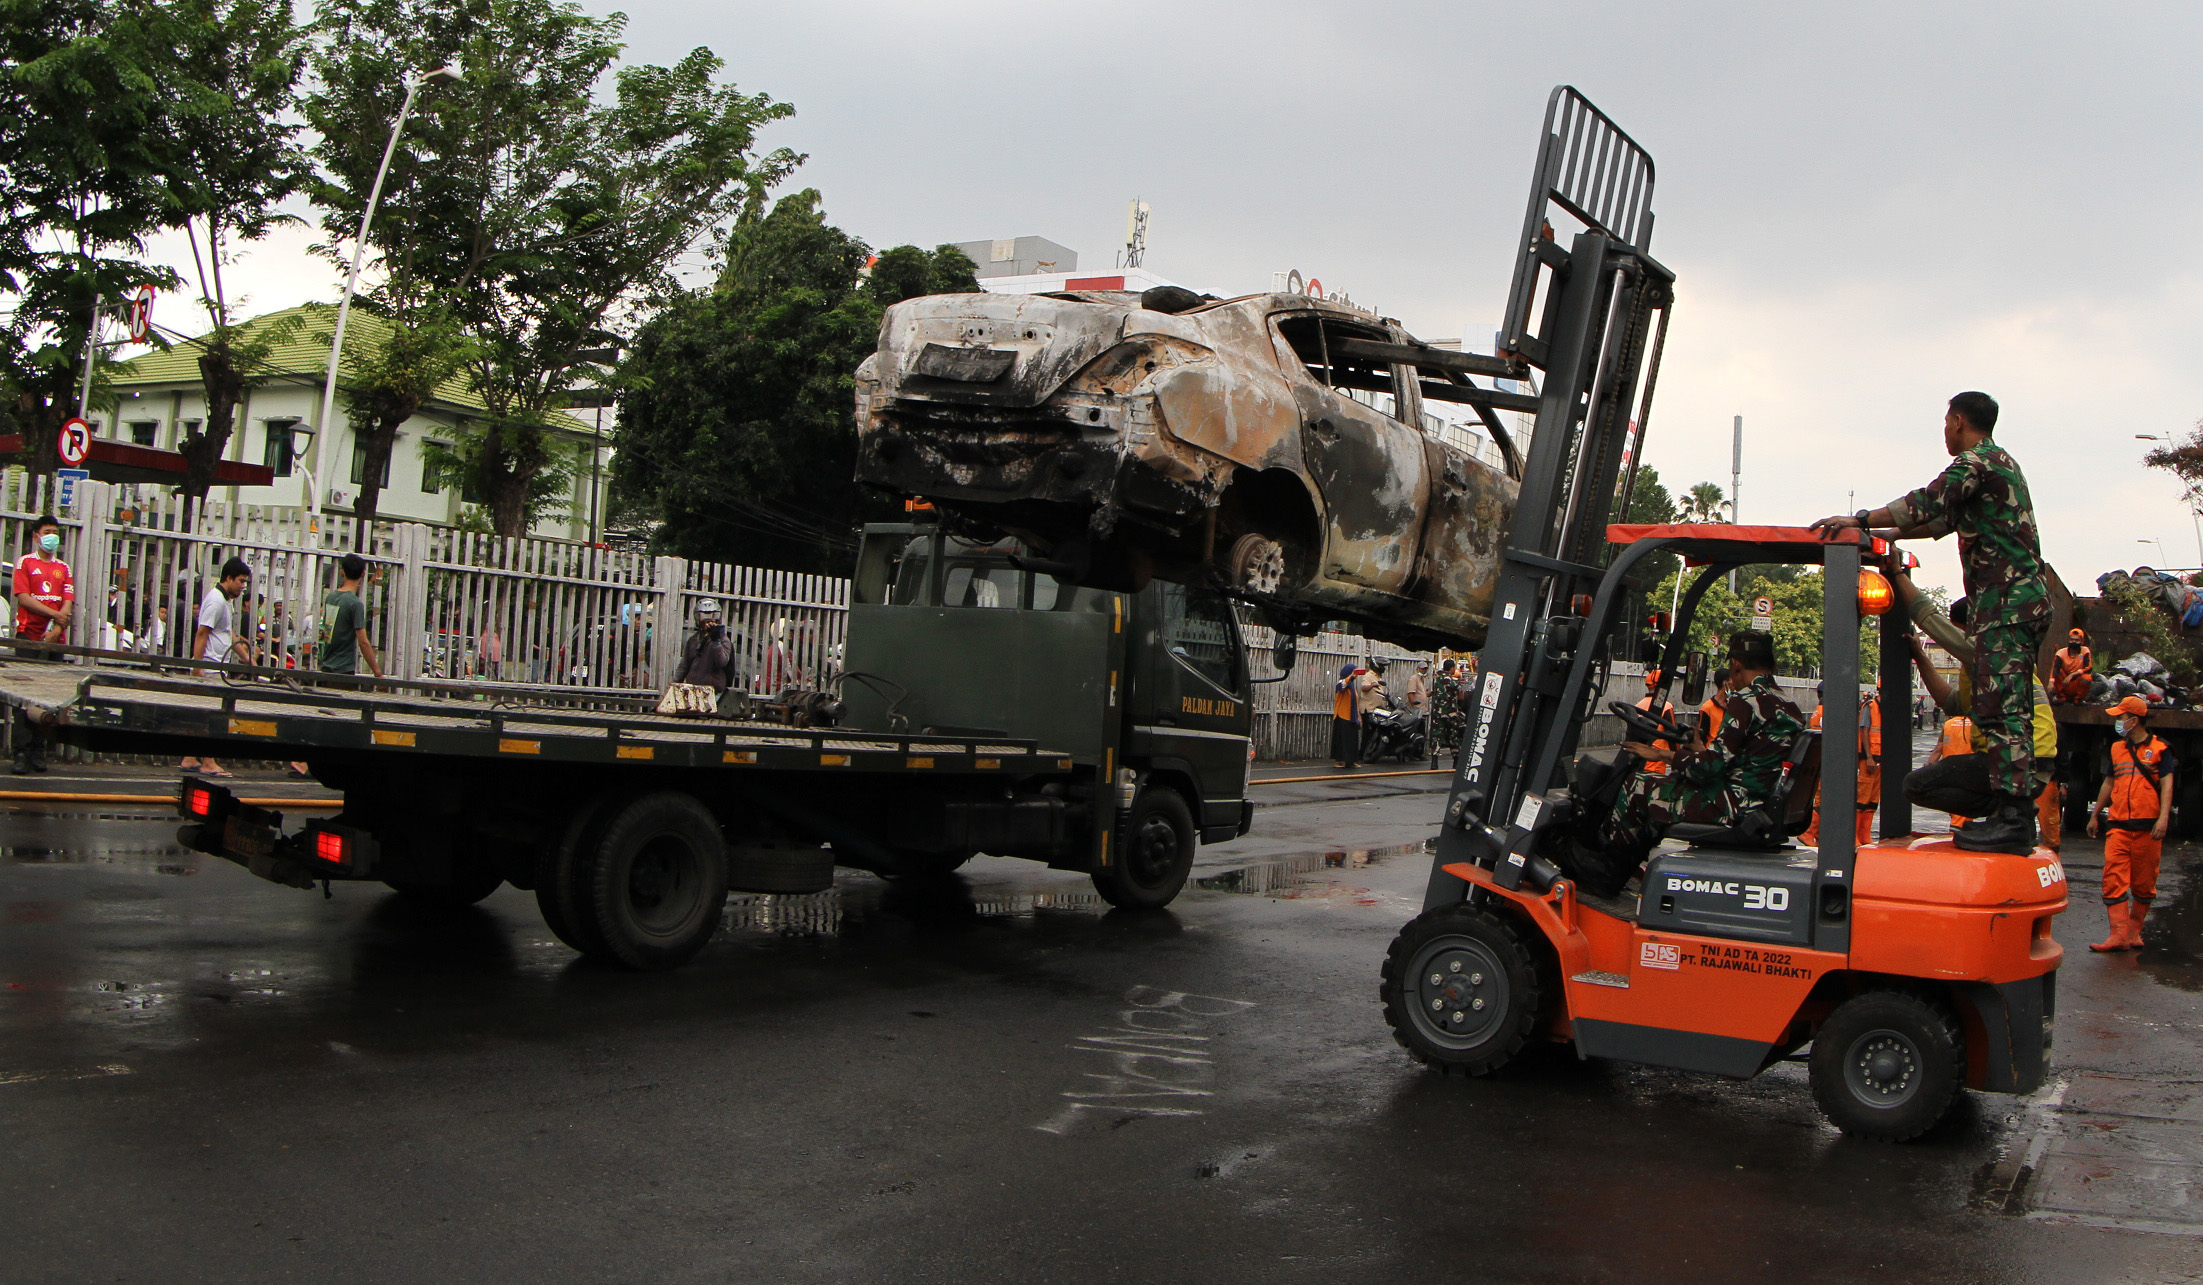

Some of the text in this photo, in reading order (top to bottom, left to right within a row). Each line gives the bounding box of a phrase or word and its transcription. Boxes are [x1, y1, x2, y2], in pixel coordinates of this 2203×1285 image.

[1182, 696, 1235, 717] PALDAM JAYA
[1467, 707, 1494, 783] BOMAC
[1667, 878, 1790, 911] BOMAC 30
[1680, 953, 1812, 980] PT. RAJAWALI BHAKTI
[1700, 944, 1792, 965] TNI AD TA 2022
